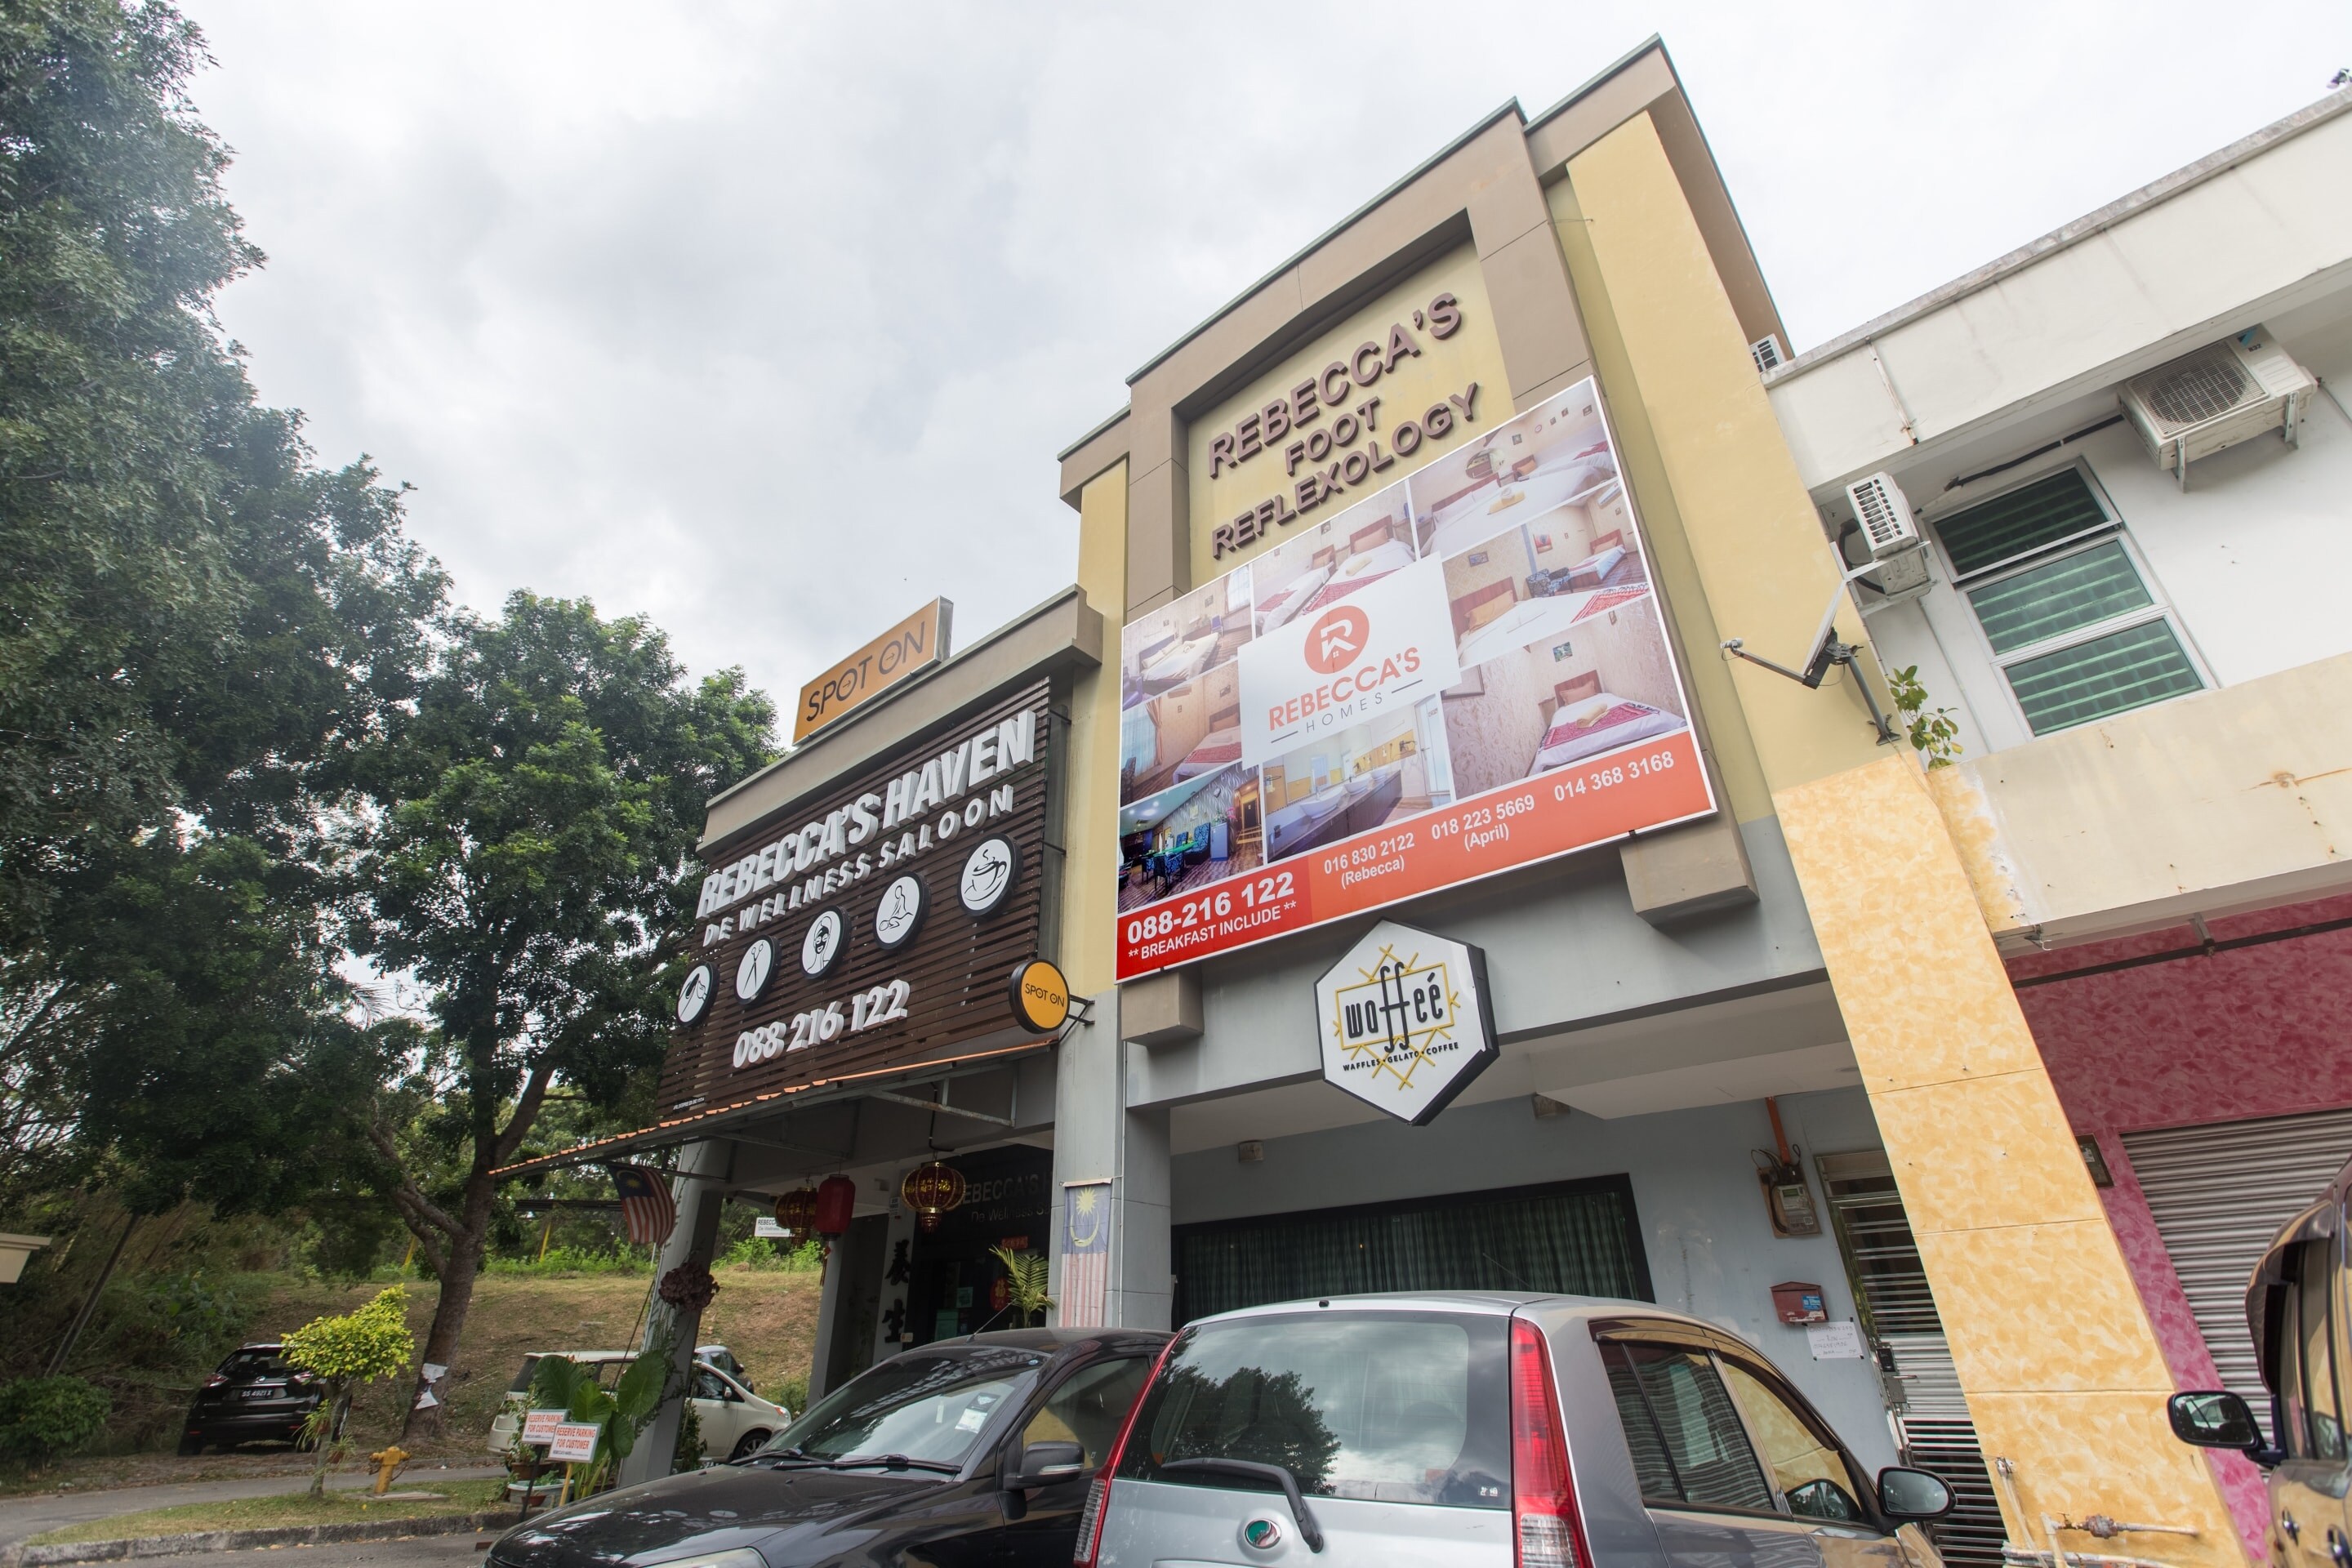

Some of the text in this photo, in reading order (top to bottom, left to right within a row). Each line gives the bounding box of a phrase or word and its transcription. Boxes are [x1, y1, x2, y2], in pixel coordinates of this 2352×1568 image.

[1208, 292, 1462, 479] REBECCA'S
[1285, 396, 1380, 476] FOOT
[1212, 381, 1479, 560] REFLEXOLOGY
[806, 621, 926, 723] SPOT ON
[1269, 647, 1420, 732] REBECCA'S
[1306, 692, 1384, 733] HOMES
[1554, 751, 1674, 801] 014 368 3168
[696, 710, 1036, 920] REBECCA'S HAVEN
[1431, 794, 1535, 840] 018 223 5669
[1463, 823, 1509, 852] (April)
[703, 784, 1013, 947] DE WELLNESS SALOON
[1324, 832, 1415, 875] 016 830 2122
[1341, 855, 1405, 889] (Rebecca)
[1127, 871, 1294, 944] 088-216 122
[1142, 905, 1281, 960] BREAKFAST INCLUDE
[1025, 983, 1065, 1007] SPOT ON
[733, 979, 910, 1068] 088 216 122
[1343, 1042, 1459, 1071] WAFFLES GELATO COFFEE
[959, 1174, 1038, 1205] EBECCA'S
[528, 1424, 555, 1433] FOR CUSTOME
[556, 1427, 576, 1437] RESERVE
[577, 1428, 596, 1438] PARKING
[557, 1439, 590, 1450] FOR CUSTOMER
